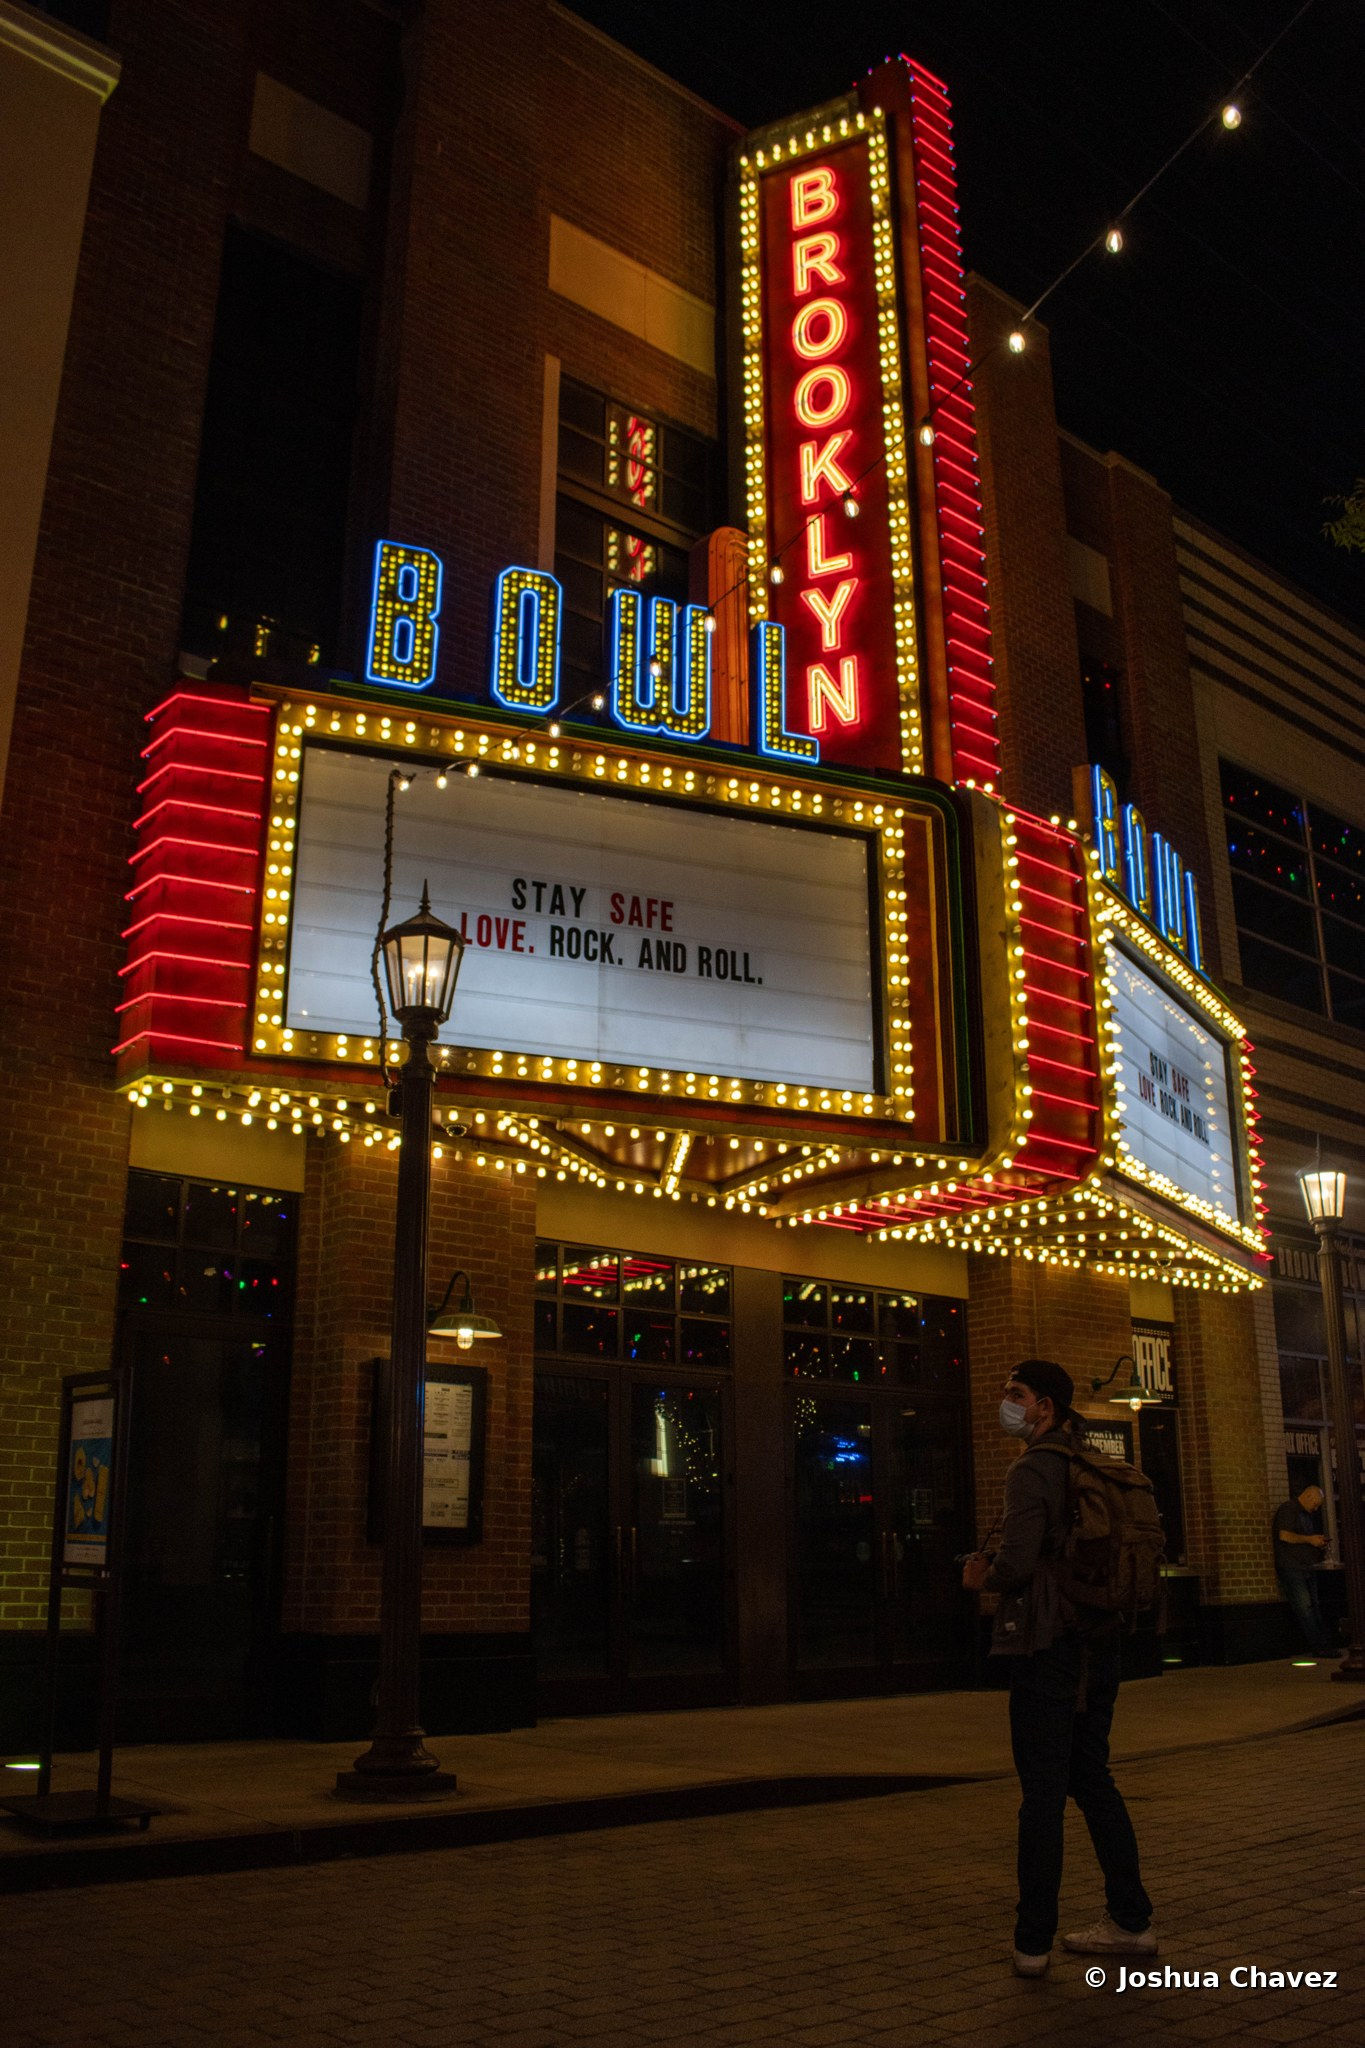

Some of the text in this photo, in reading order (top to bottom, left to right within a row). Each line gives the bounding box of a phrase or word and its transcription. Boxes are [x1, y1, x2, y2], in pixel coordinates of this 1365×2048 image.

[789, 167, 861, 733] BROOKLYN
[365, 538, 820, 765] BOWL
[511, 877, 675, 932] STAY SAFE
[460, 911, 764, 985] LOVE. ROCK. AND ROLL.
[1149, 1051, 1190, 1103] STAY SAFE
[1180, 1103, 1194, 1133] AND
[1131, 1334, 1174, 1392] OFFICE
